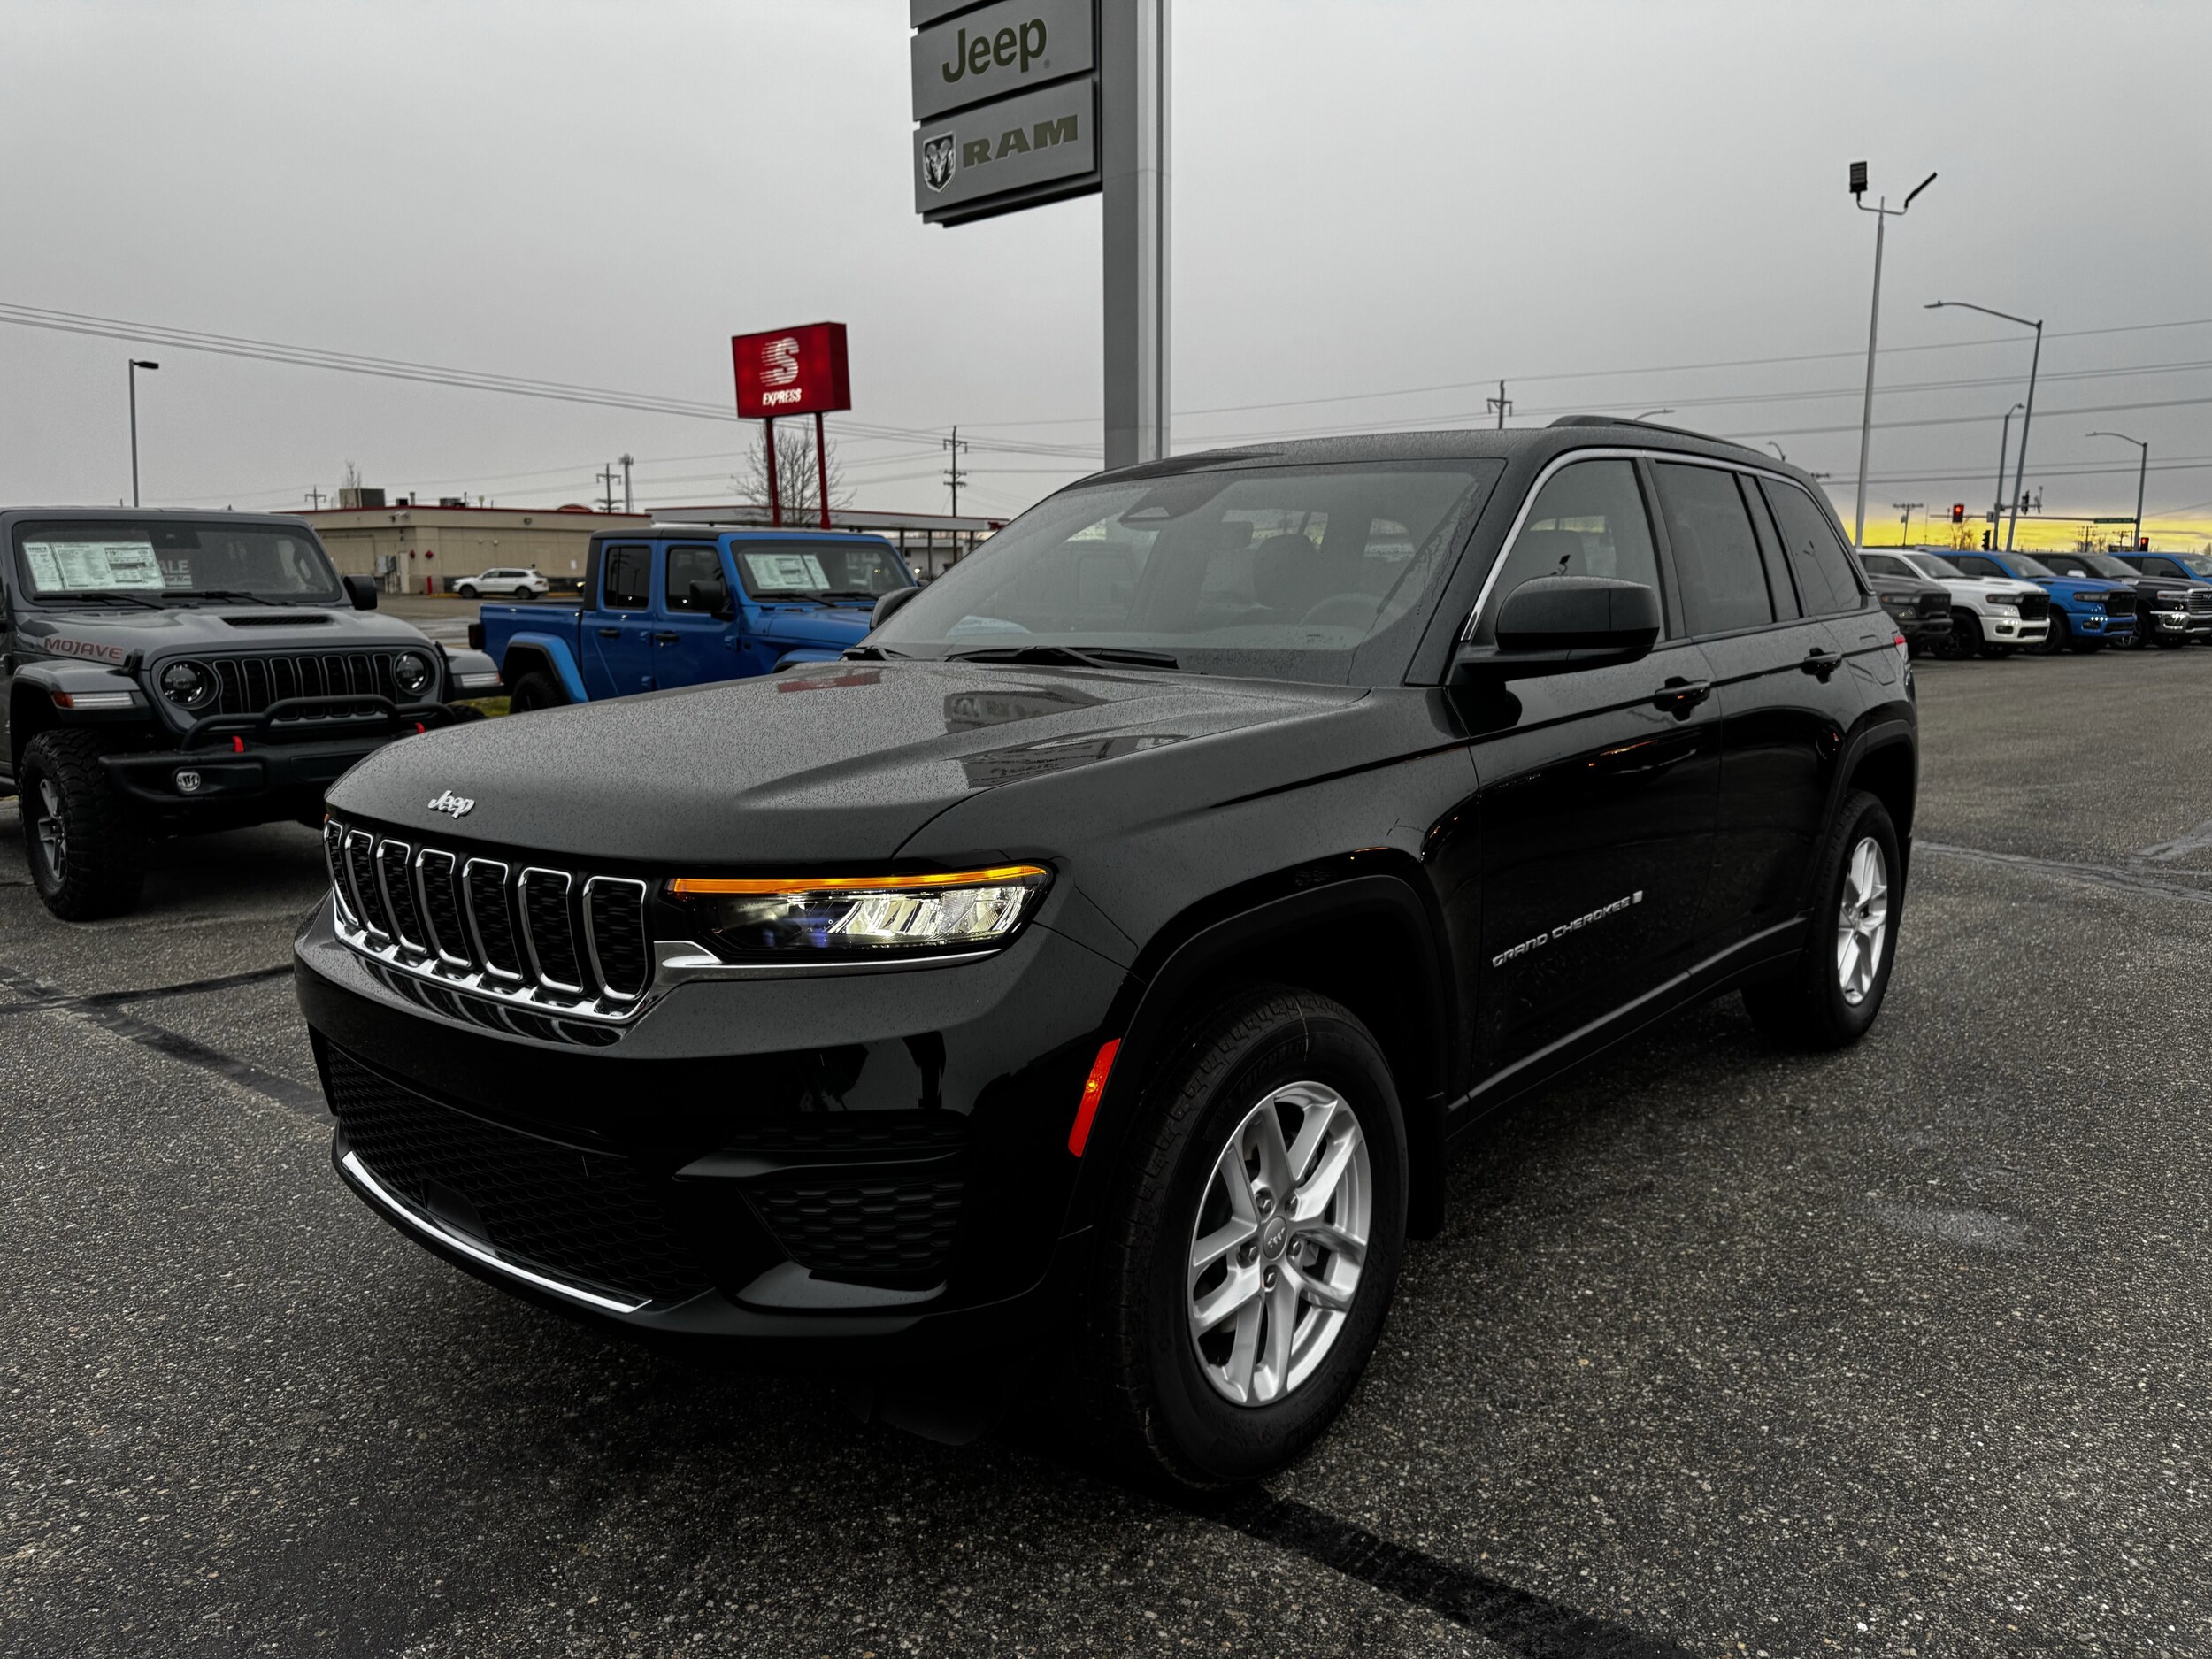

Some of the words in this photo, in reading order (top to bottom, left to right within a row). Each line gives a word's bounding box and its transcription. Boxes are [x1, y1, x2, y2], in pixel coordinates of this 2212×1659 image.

[942, 18, 1047, 83] Jeep
[962, 114, 1079, 169] RAM
[762, 388, 803, 407] EXPRESS
[43, 637, 124, 660] MOJAVE
[427, 790, 475, 819] Jeep
[1492, 933, 1548, 969] GRAND
[1551, 896, 1631, 940] CHEROKEE
